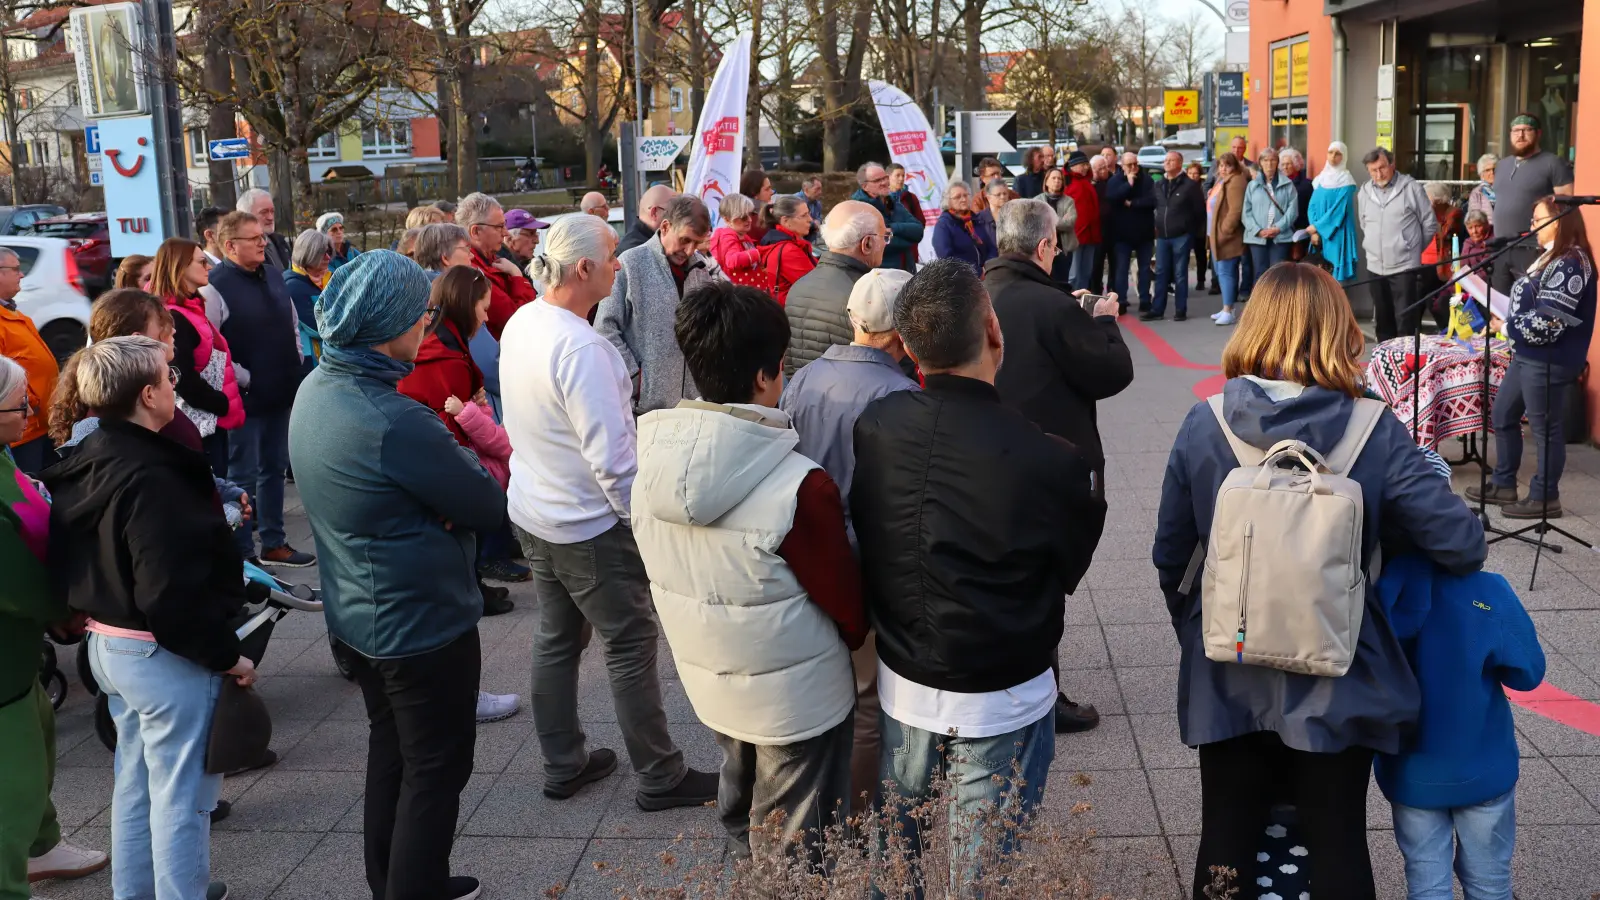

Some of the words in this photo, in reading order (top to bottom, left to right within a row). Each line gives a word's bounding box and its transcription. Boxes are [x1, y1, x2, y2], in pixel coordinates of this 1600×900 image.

[73, 16, 81, 52] HANS
[80, 60, 90, 115] HERTEL
[116, 217, 149, 233] TUI
